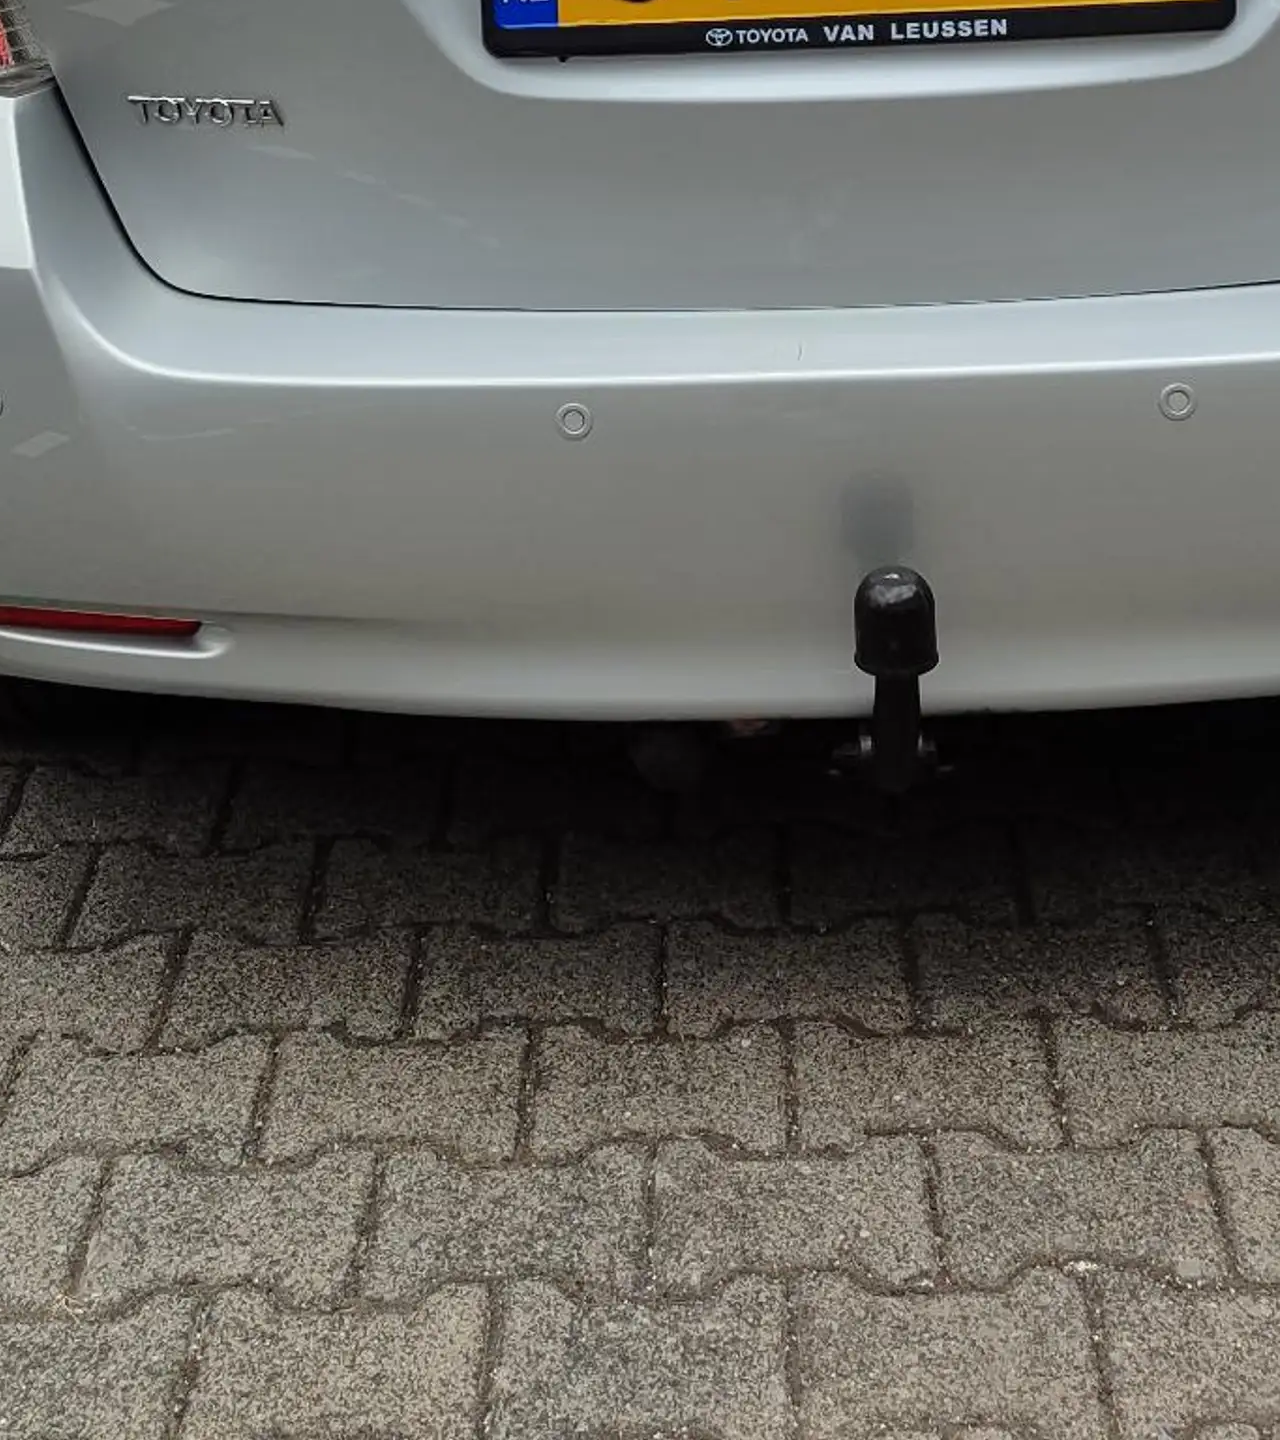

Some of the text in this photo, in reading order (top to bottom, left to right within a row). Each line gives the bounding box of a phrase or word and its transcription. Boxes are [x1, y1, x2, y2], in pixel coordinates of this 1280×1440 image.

[736, 18, 1008, 44] TOYOTA VAN LEUSSEN
[127, 94, 285, 128] TOYOTA
